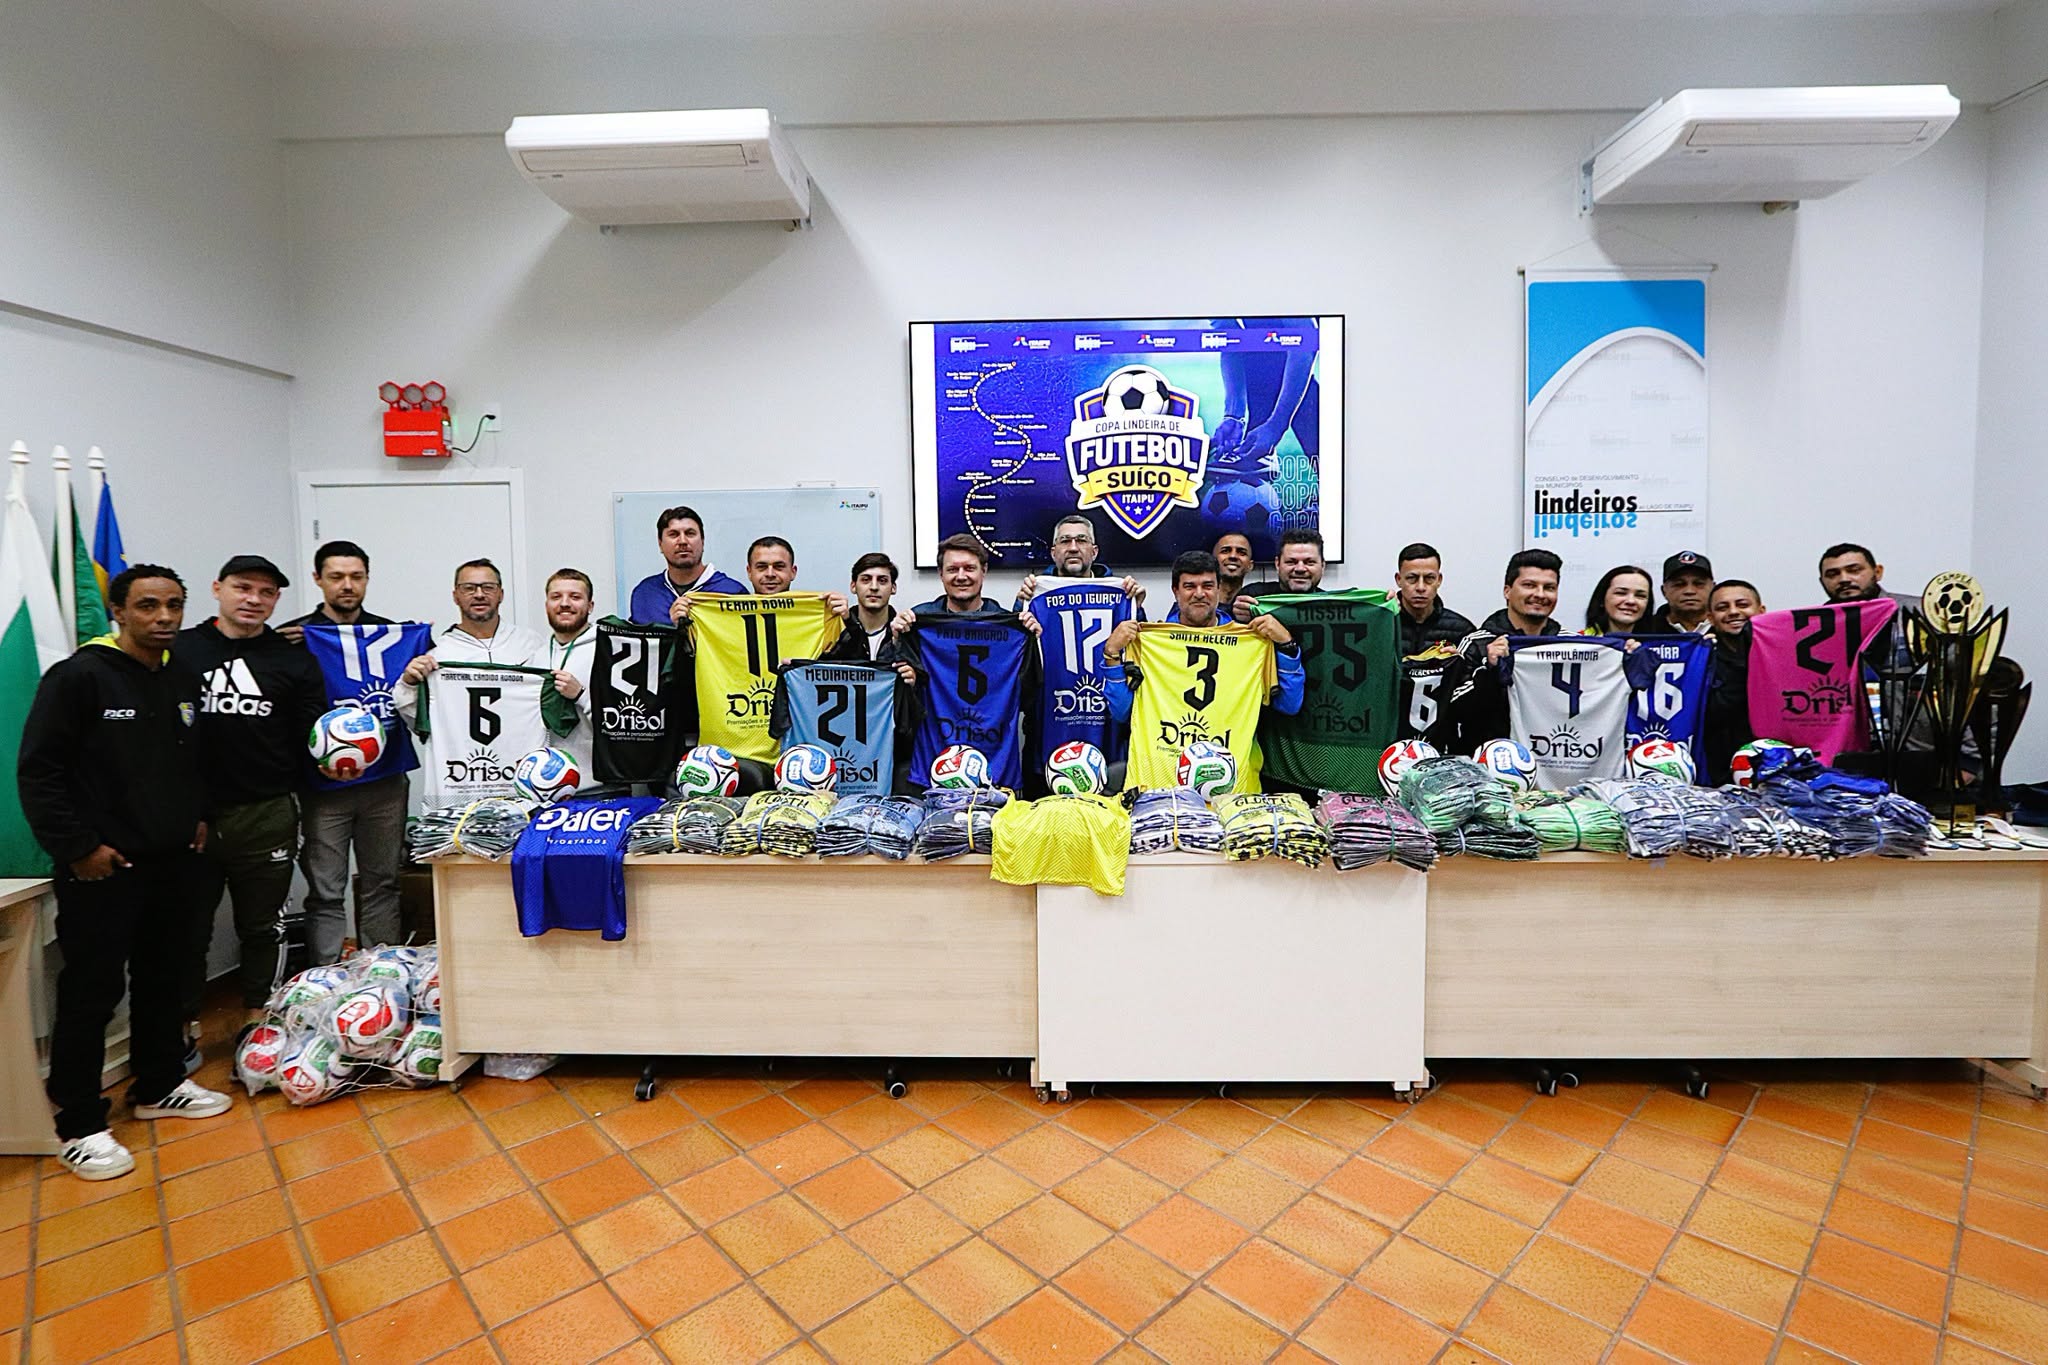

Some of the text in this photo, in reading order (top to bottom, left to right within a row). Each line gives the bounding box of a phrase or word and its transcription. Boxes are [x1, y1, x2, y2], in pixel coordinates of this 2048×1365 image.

[1095, 419, 1181, 433] COPA LINDEIRA DE
[1080, 434, 1198, 472] FUTEBOL
[1107, 467, 1172, 489] SUÍÇO
[1269, 455, 1319, 482] COPA
[1122, 494, 1155, 503] ITAIPU
[1269, 483, 1319, 510] COPA
[1535, 489, 1638, 514] lindeiros
[718, 601, 758, 611] TERRA
[1046, 594, 1122, 607] FOZ DO IGUAÇU
[1296, 605, 1356, 621] MISSAL
[741, 613, 780, 677] 11
[1058, 609, 1113, 674] 17
[1170, 633, 1238, 646] SANTA HELENA
[1792, 606, 1862, 675] 21
[608, 635, 660, 696] 21
[1537, 649, 1598, 661] ITAIPULÂNDIA
[805, 669, 875, 681] MEDIANEIRA
[957, 644, 990, 706] 6
[1184, 646, 1219, 712] 3
[1053, 689, 1107, 713] Dris
[1410, 675, 1443, 732] 6
[1552, 663, 1583, 719] 4
[1781, 683, 1854, 715] Drisl
[200, 691, 274, 717] didas
[465, 687, 501, 746] 6
[726, 694, 777, 717] Dri
[815, 685, 867, 747] 21
[602, 707, 666, 730] Drisol
[1311, 708, 1372, 733] risol
[935, 717, 1004, 746] Drisol
[1529, 734, 1604, 758] Drisol
[444, 760, 516, 782] Driso
[836, 759, 879, 783] isol
